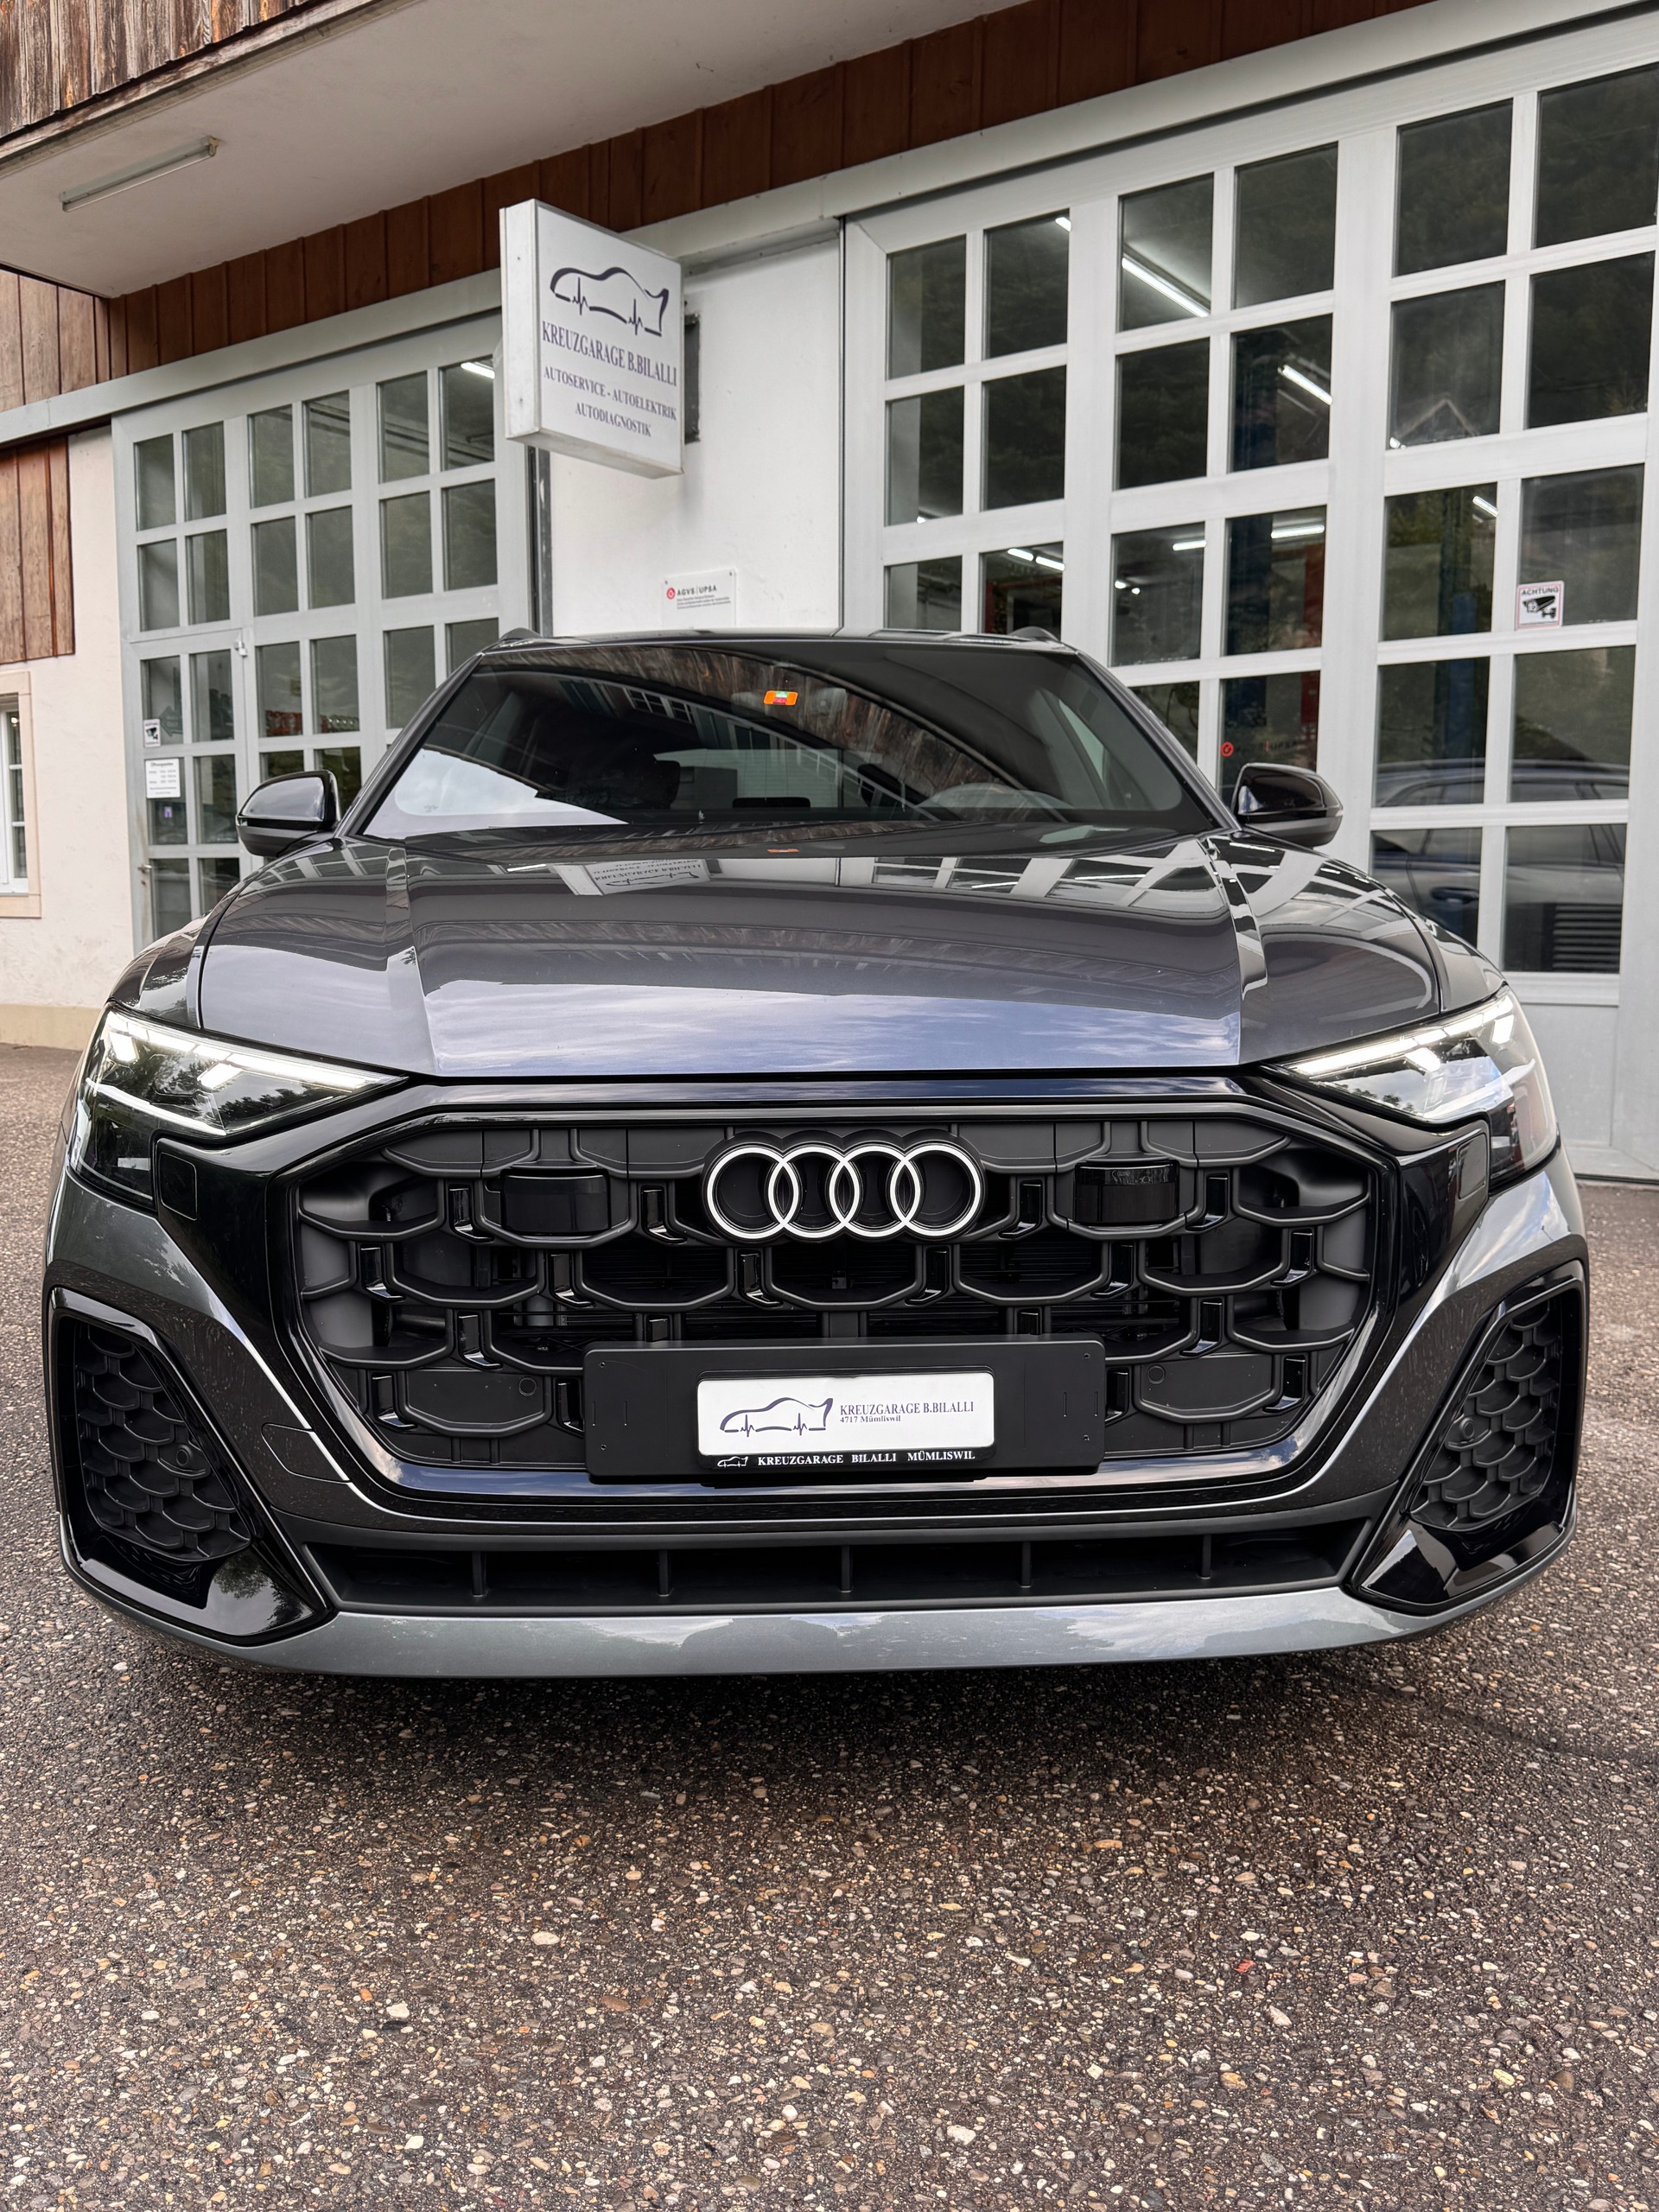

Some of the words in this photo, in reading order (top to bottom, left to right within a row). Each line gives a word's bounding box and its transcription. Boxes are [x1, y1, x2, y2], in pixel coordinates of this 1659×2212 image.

[542, 321, 625, 369] KREUZGARAGE
[628, 351, 677, 386] B.BILALLI
[543, 366, 606, 397] AUTOSERVICE
[612, 388, 677, 421] AUTOELEKTRIK
[575, 402, 652, 437] AUTODIAGNOSTIK
[699, 585, 717, 594] UPSA
[1522, 587, 1559, 595] ACHTUNG
[840, 1402, 920, 1416] KREUZGARAGE
[923, 1401, 975, 1414] B.BILALLI
[860, 1414, 901, 1423] Mümliswil
[758, 1454, 844, 1466] KREUZGARAGE
[851, 1452, 897, 1464] BILALLI
[907, 1450, 976, 1462] MÜMLISWIL
